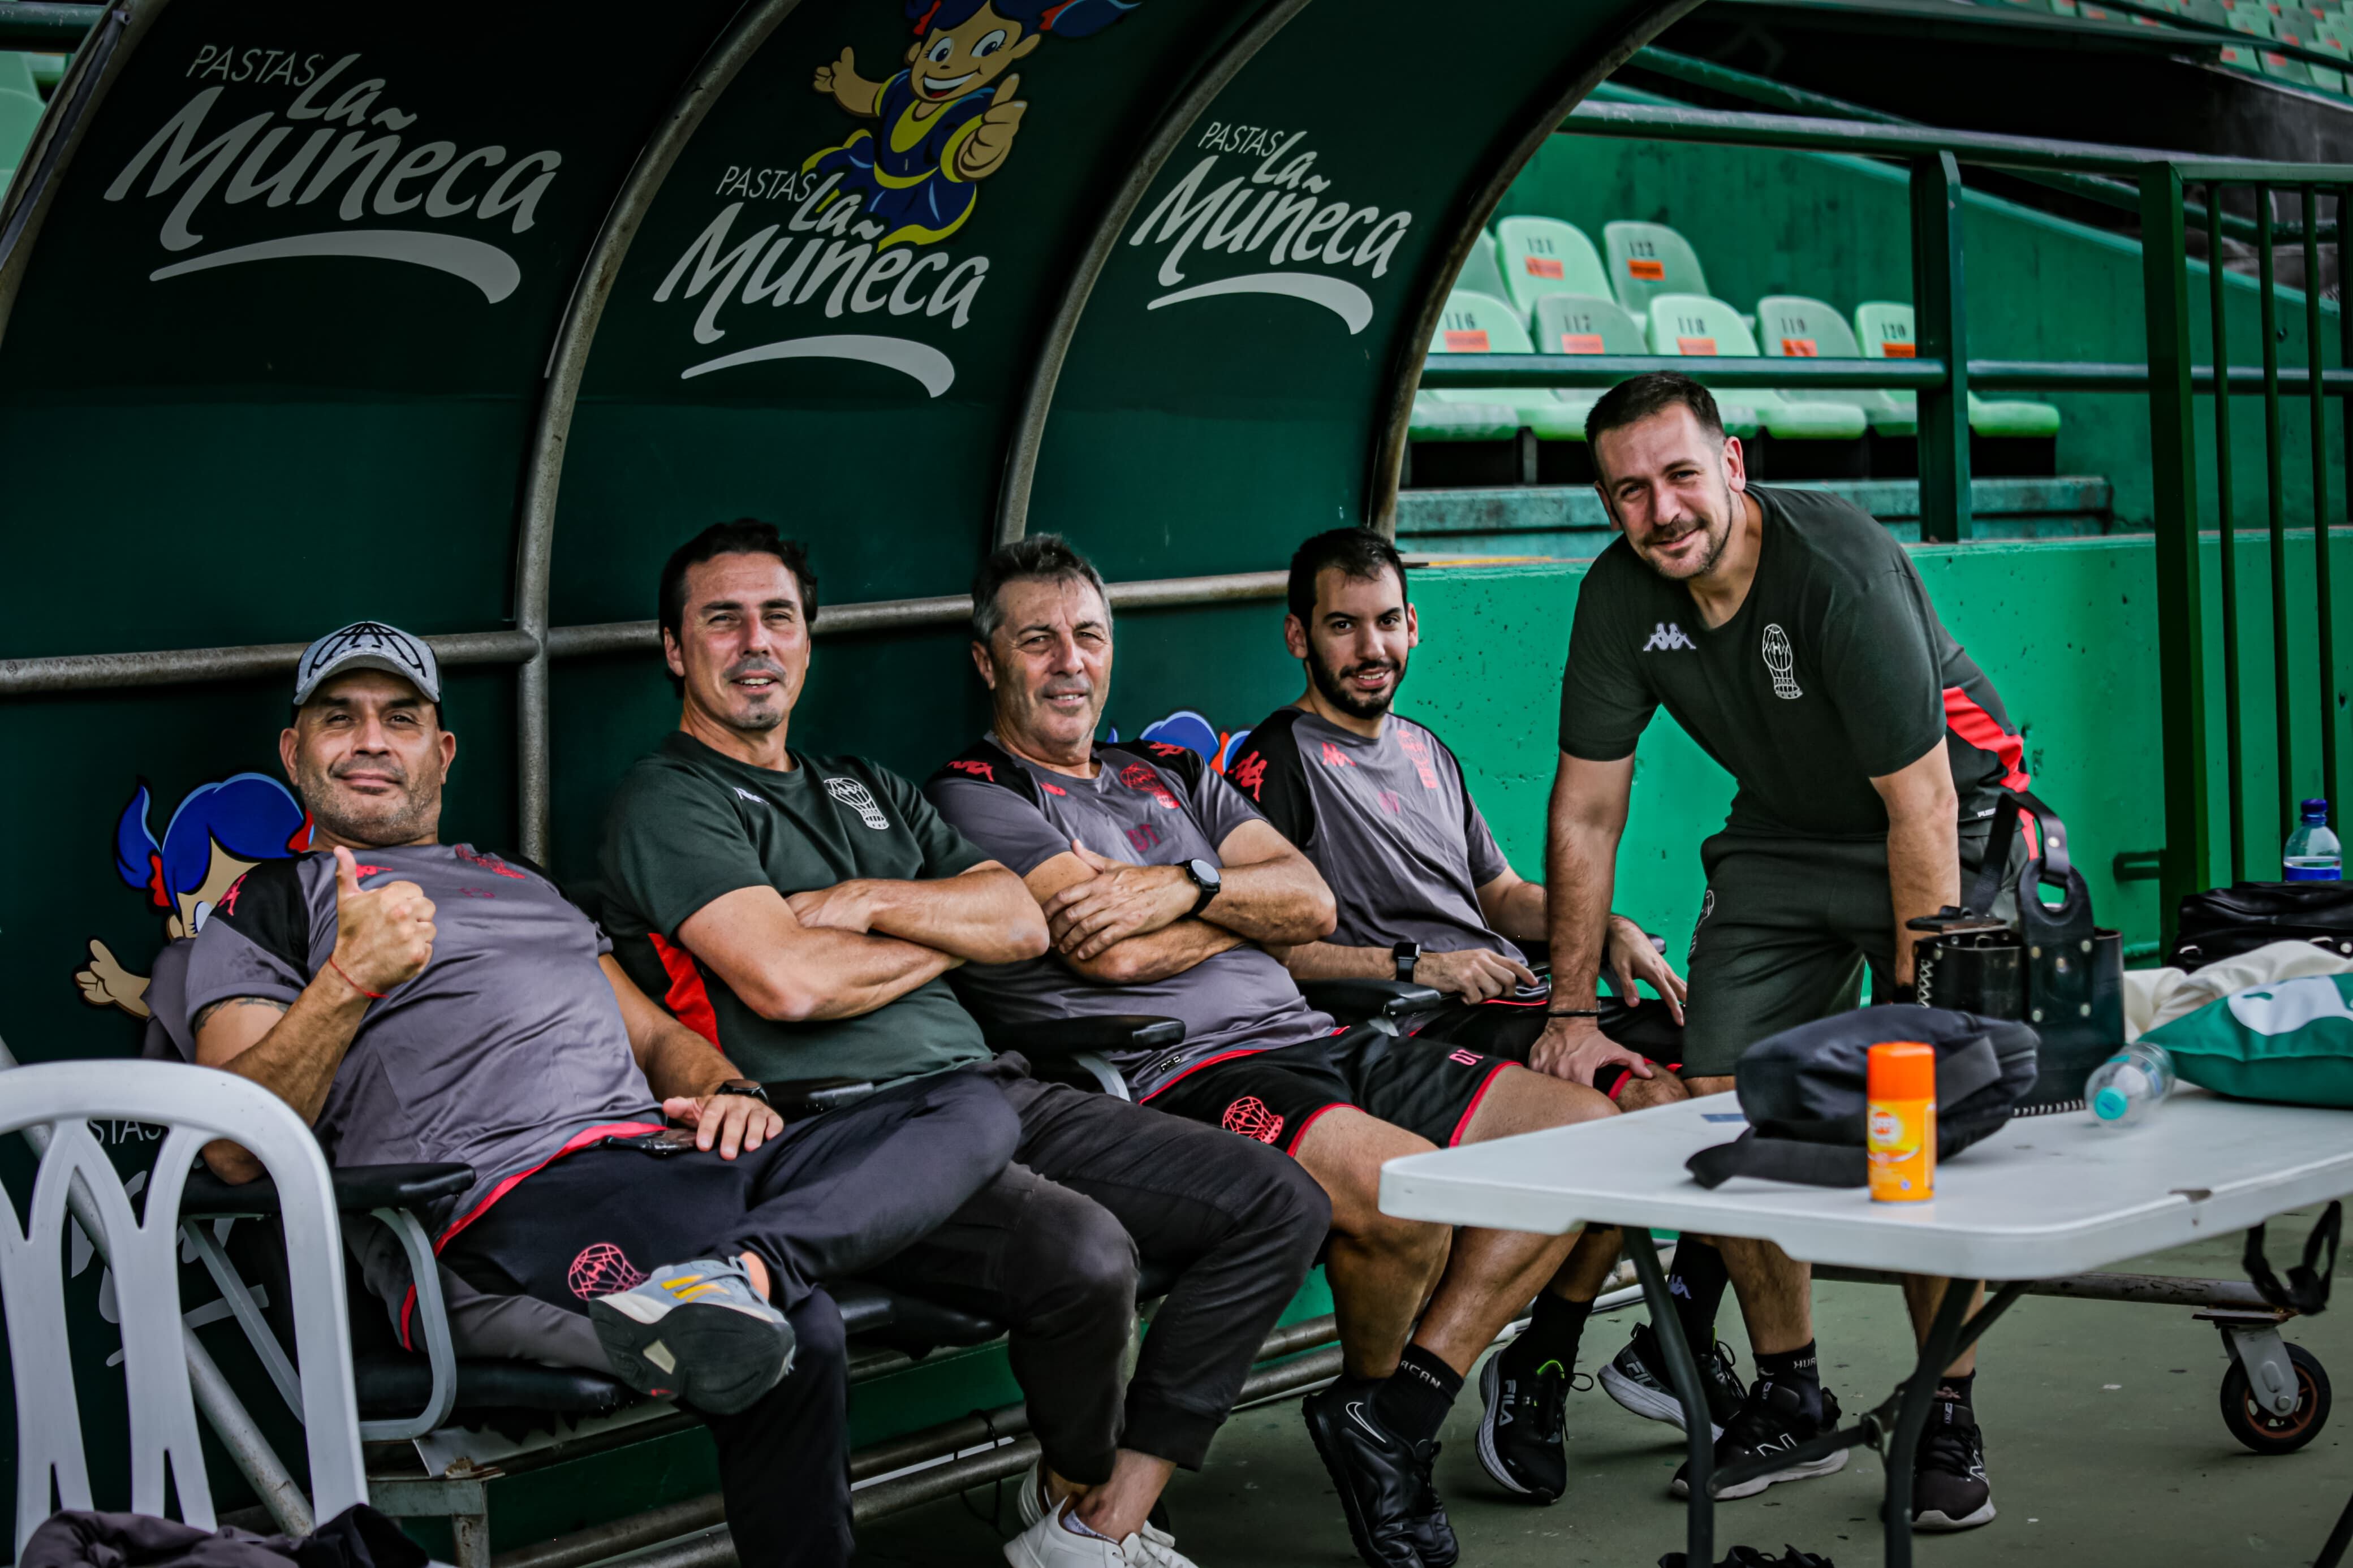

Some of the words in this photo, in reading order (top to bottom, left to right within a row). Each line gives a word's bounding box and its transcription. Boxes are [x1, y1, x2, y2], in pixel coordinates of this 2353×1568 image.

[186, 45, 324, 87] PASTAS
[287, 53, 386, 126] La
[104, 86, 562, 252] Muñeca
[1198, 121, 1284, 158] PASTAS
[1252, 131, 1317, 190] La
[716, 166, 818, 202] PASTAS
[788, 172, 863, 237] La
[1128, 155, 1412, 287] Muñeca
[1527, 236, 1555, 254] 121
[652, 202, 989, 344] Muñeca
[1446, 312, 1476, 331] 116
[1563, 314, 1591, 333] 117
[1781, 317, 1805, 335] 119
[1882, 323, 1906, 340] 120
[1126, 823, 1162, 853] DT
[1449, 1049, 1484, 1066] DT
[1498, 1379, 1516, 1427] FILA
